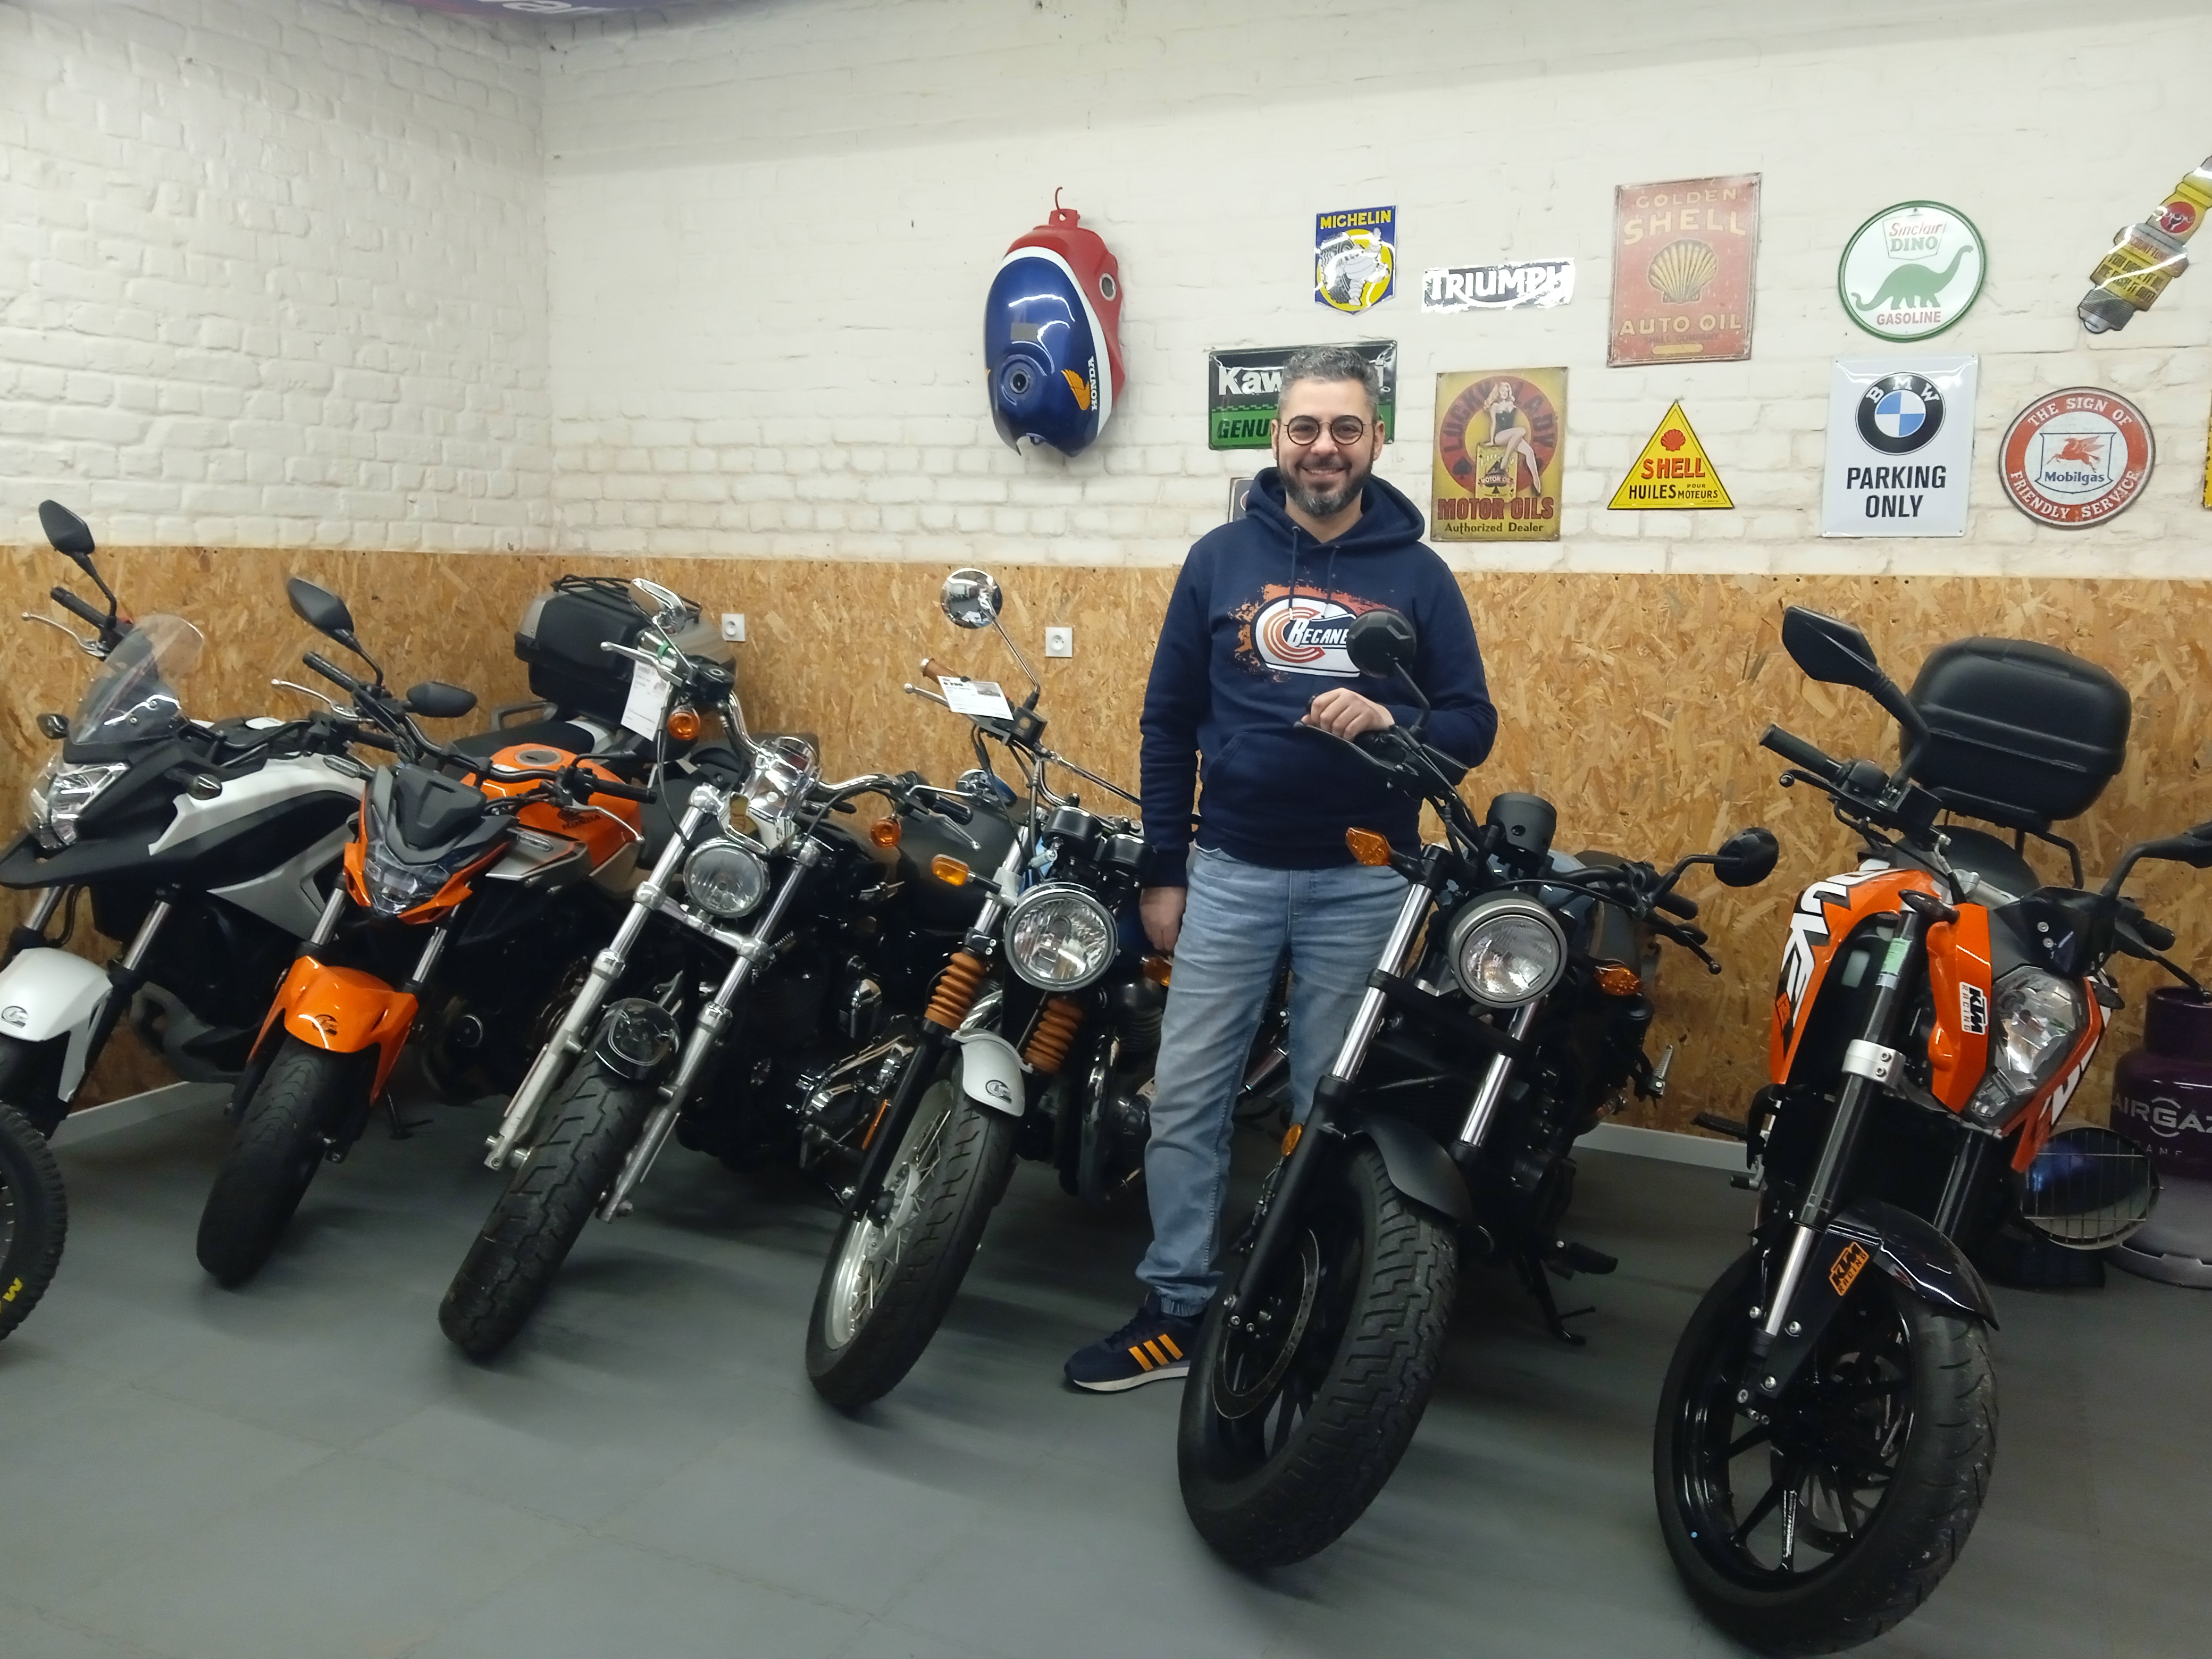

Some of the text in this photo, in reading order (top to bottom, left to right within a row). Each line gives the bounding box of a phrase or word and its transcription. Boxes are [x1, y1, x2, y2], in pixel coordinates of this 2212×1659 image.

[1636, 188, 1736, 208] GOLDEN
[1320, 210, 1392, 229] MICHELIN
[1624, 208, 1746, 246] SHELL
[1889, 221, 1943, 237] Sinclair
[1890, 236, 1938, 252] DINO
[1427, 265, 1570, 301] TRIUMPH
[1619, 314, 1742, 336] AUTO OIL
[1876, 311, 1942, 325] GASOLINE
[1644, 332, 1720, 343] SHELL COMPANY
[1087, 356, 1097, 412] HONDA
[1866, 375, 1940, 404] BMW
[2027, 397, 2133, 426] THE SIGN OF
[1480, 475, 1501, 484] MOTOR
[1641, 458, 1706, 479] SHELL
[1847, 465, 1947, 489] PARKING
[2045, 472, 2105, 485] Mobilgas
[1629, 484, 1718, 499] HUILES MOTEURS
[2010, 470, 2139, 519] FRIENDLY SERVICE
[1437, 497, 1554, 520] MOTOR OILS
[1865, 495, 1924, 518] ONLY
[1444, 522, 1544, 534] Authorized Dealer
[1962, 984, 1971, 1031] RACING
[1969, 987, 1986, 1034] KTM
[1831, 1244, 1862, 1287] KTM
[1838, 1252, 1867, 1294] RACING
